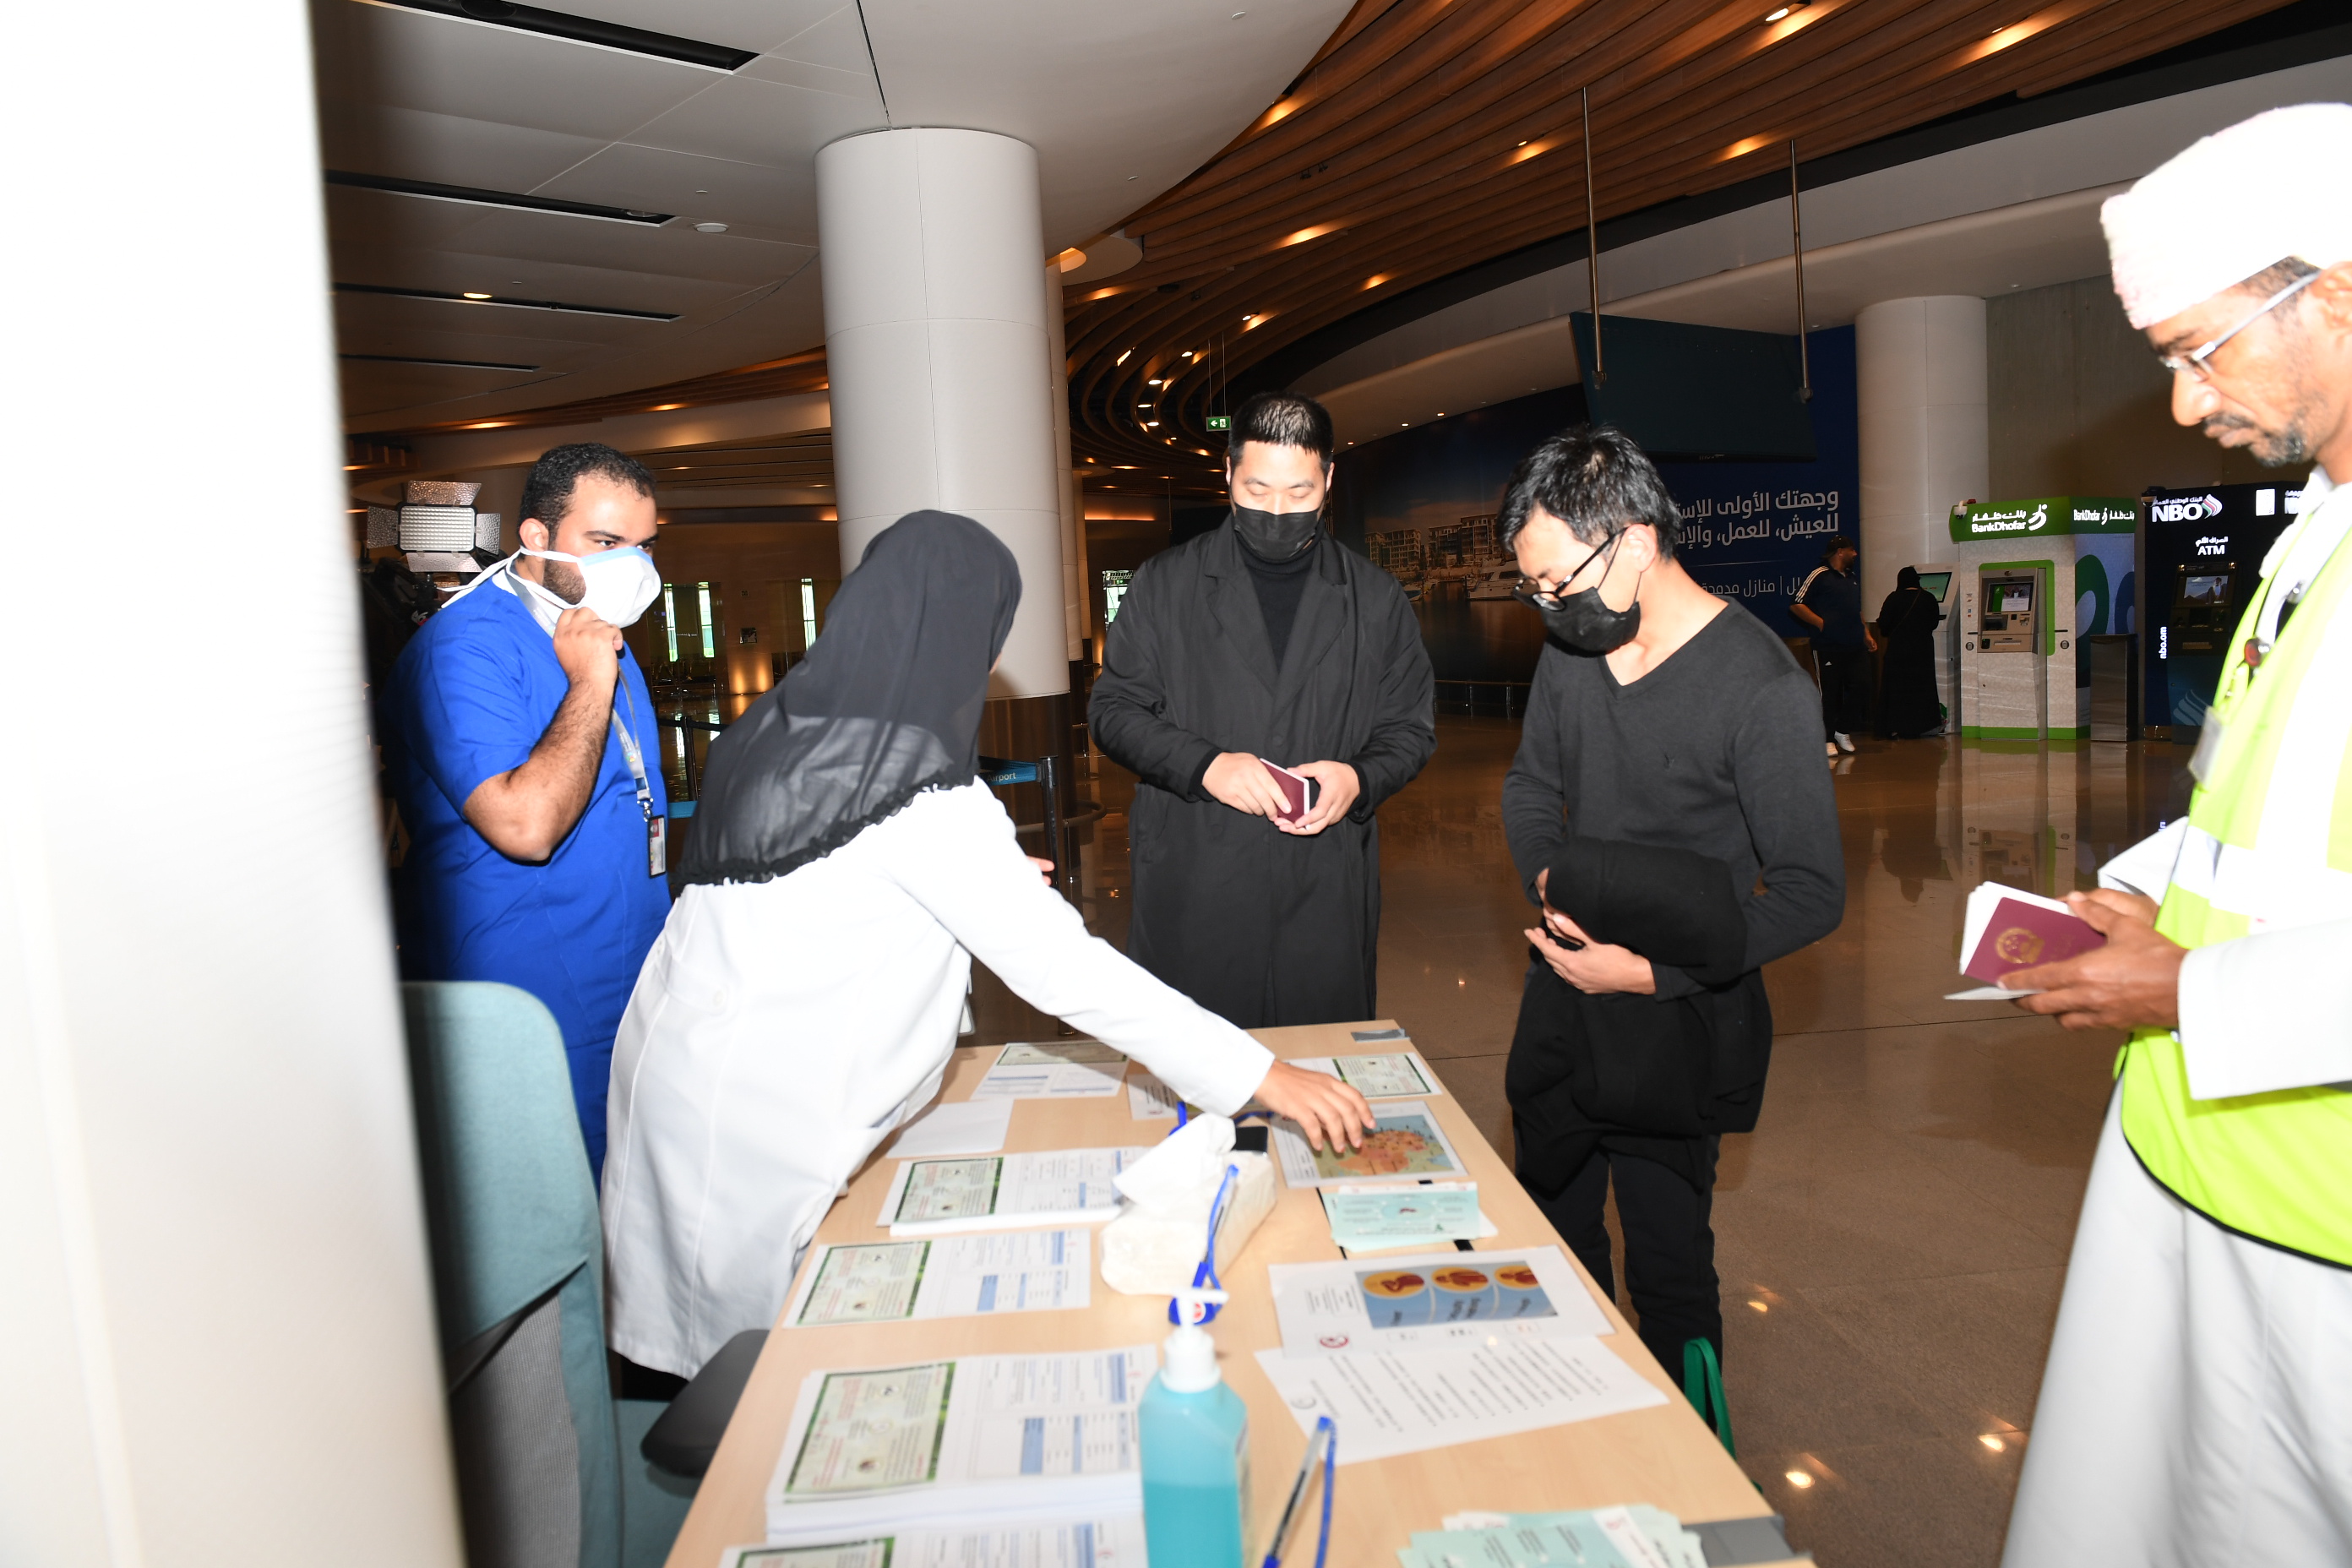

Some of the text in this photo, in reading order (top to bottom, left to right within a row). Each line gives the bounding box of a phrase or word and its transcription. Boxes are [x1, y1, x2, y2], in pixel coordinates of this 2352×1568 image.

[1717, 491, 1770, 519] الأولى
[1775, 490, 1838, 511] وجهتك
[2073, 509, 2101, 521] BankDhofar
[2152, 503, 2203, 523] NBO
[1971, 520, 2027, 533] BankDhofar
[2197, 544, 2225, 556] ATM
[1743, 579, 1776, 597] منازل
[2158, 626, 2167, 660] nbo.om
[987, 771, 1016, 782] Airport
